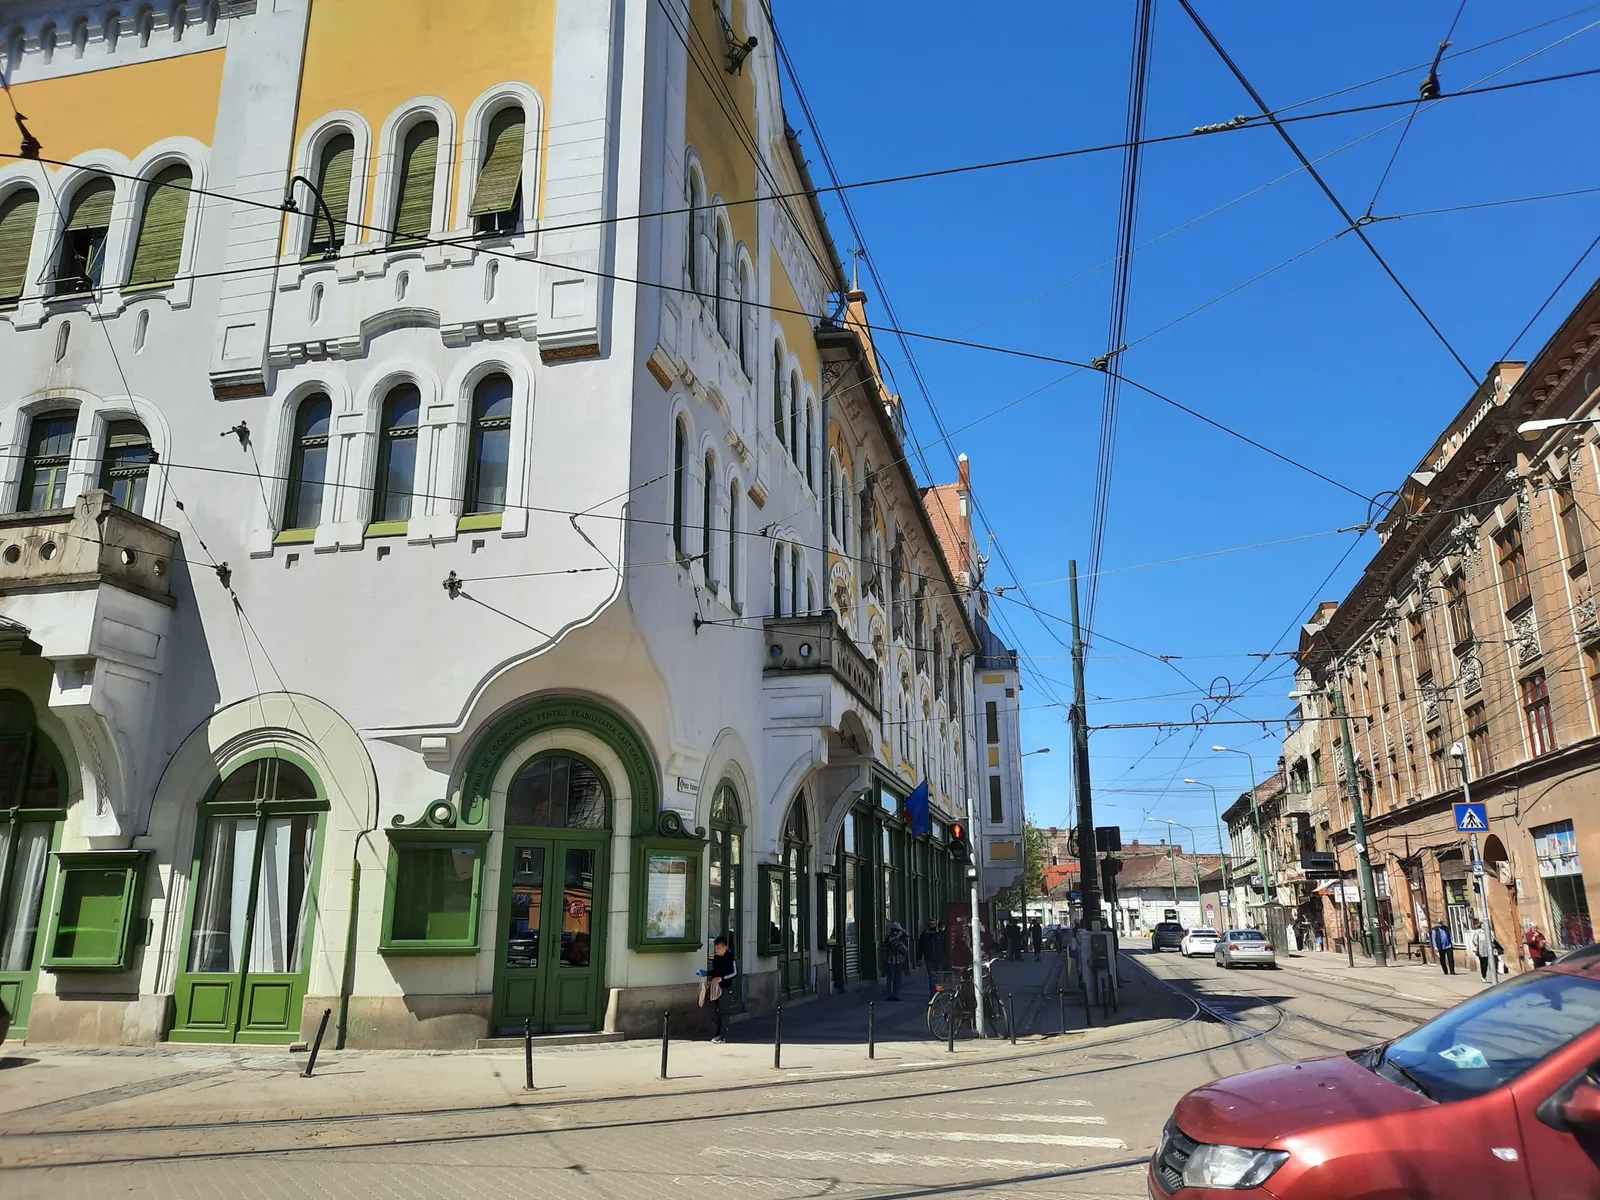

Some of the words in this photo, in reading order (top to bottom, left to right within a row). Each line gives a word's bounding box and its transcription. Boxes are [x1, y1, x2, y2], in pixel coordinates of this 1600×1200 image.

[471, 772, 484, 809] CENTRUL
[483, 757, 492, 768] DE
[489, 716, 535, 756] COORDONARE
[536, 709, 567, 721] PENTRU
[571, 710, 616, 734] REABILITAREA
[617, 732, 645, 777] CARTIERELOR
[641, 779, 650, 814] ISTORICE
